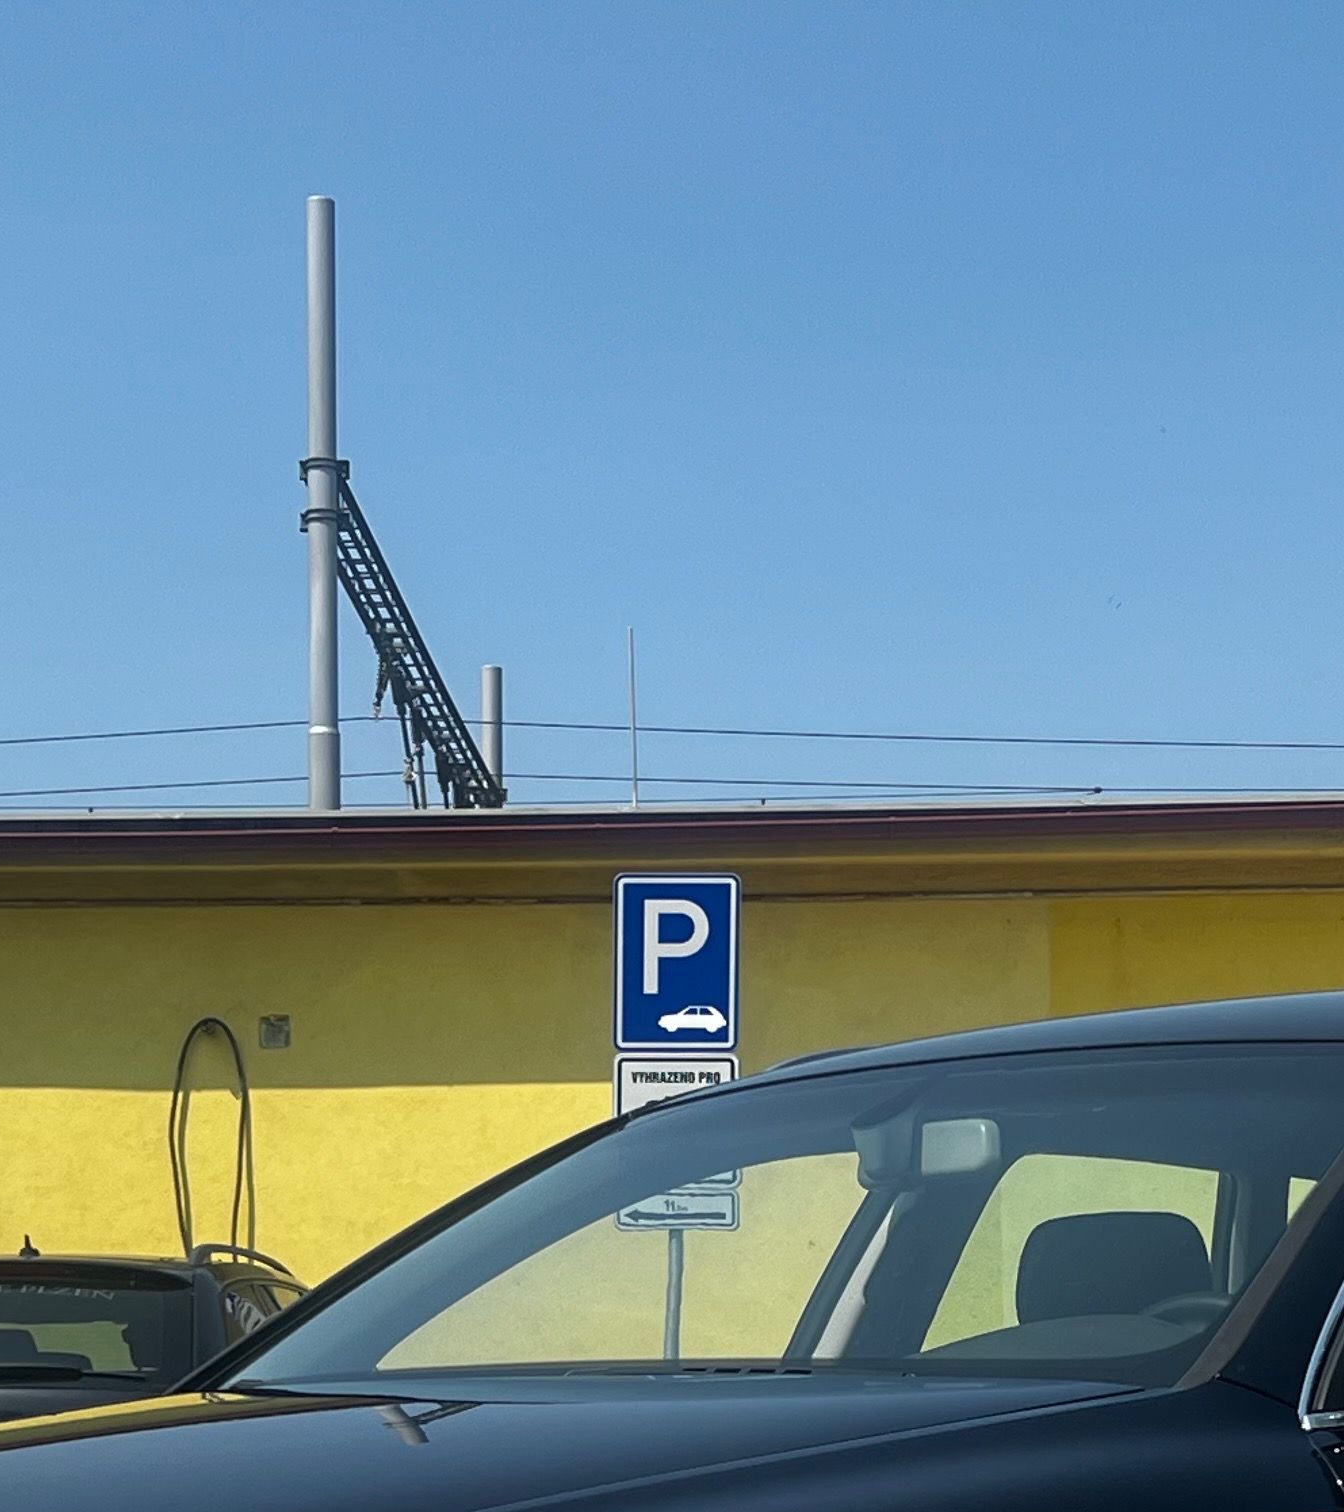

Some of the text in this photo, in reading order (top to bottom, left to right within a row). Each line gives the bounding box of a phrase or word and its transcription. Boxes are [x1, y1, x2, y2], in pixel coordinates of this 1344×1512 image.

[643, 899, 709, 994] P
[631, 1071, 721, 1085] VYHRAZENO PRO
